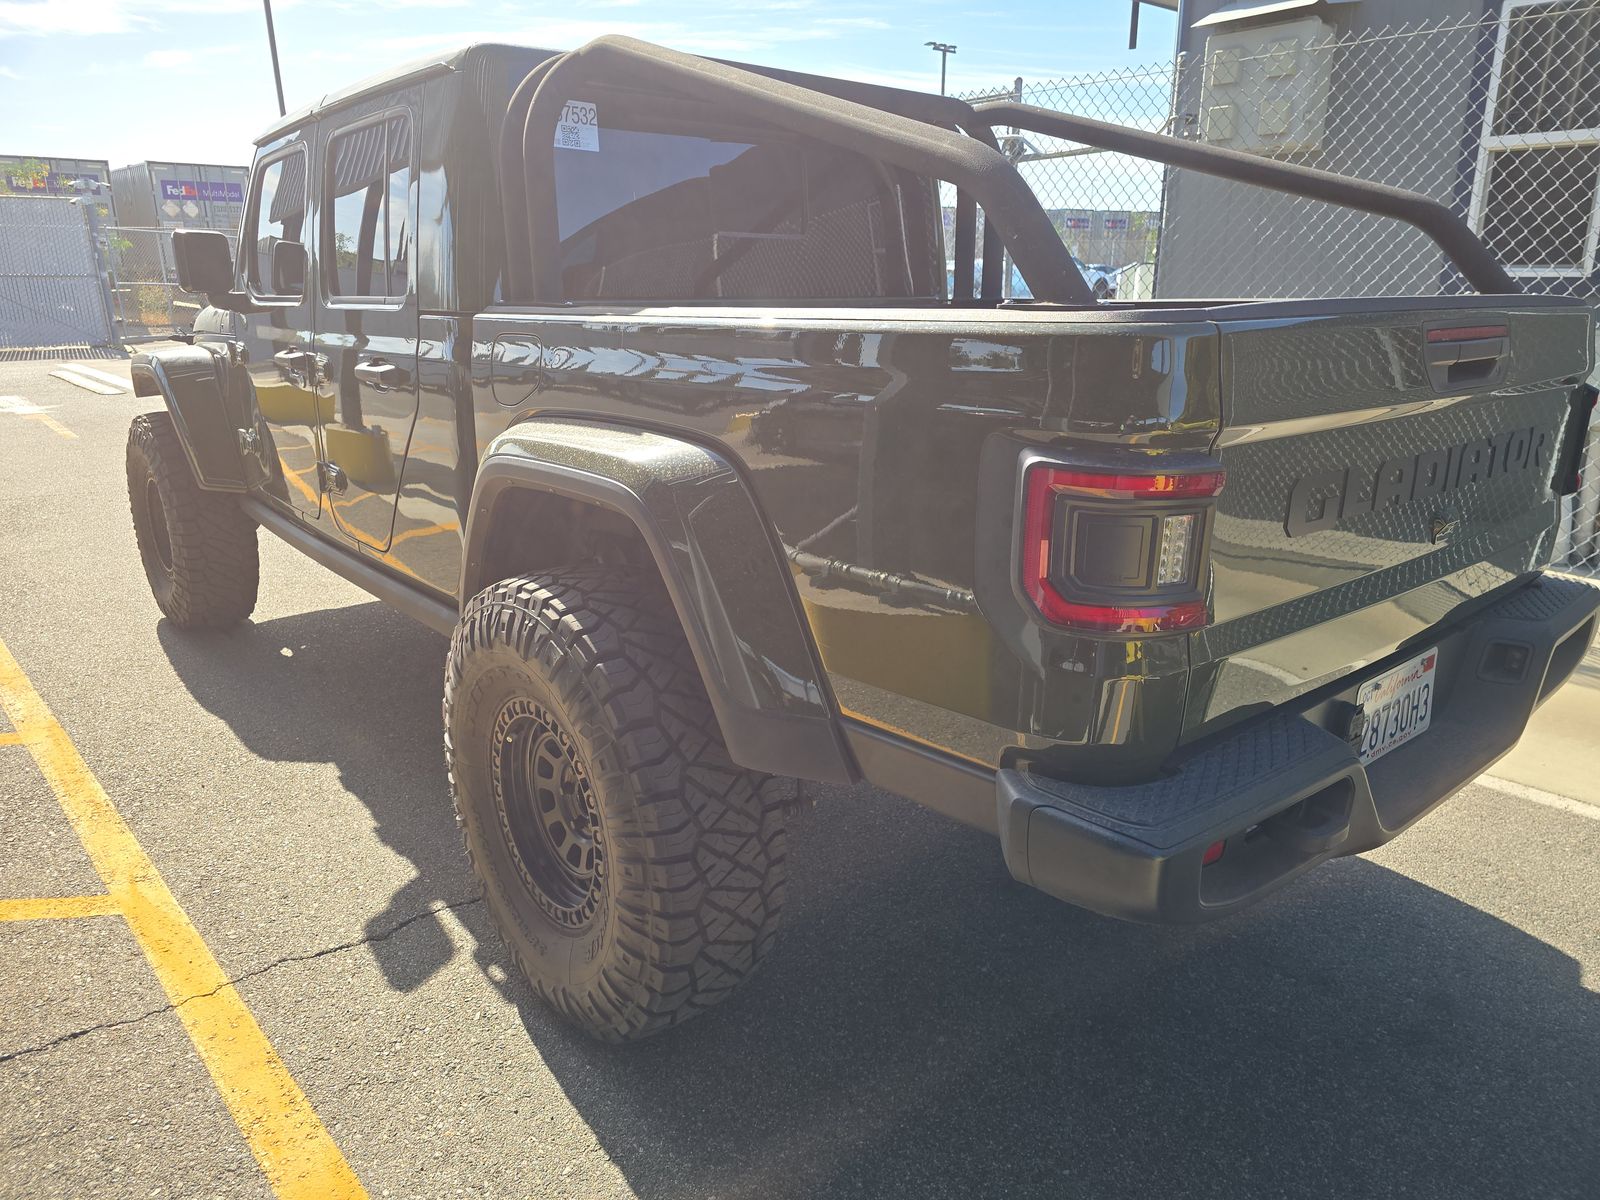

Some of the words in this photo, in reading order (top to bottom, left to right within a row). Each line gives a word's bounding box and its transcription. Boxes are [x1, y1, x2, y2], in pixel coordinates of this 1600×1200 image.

[558, 104, 597, 126] 7532
[166, 184, 198, 196] FedEx
[1283, 427, 1545, 538] GLADIATOR
